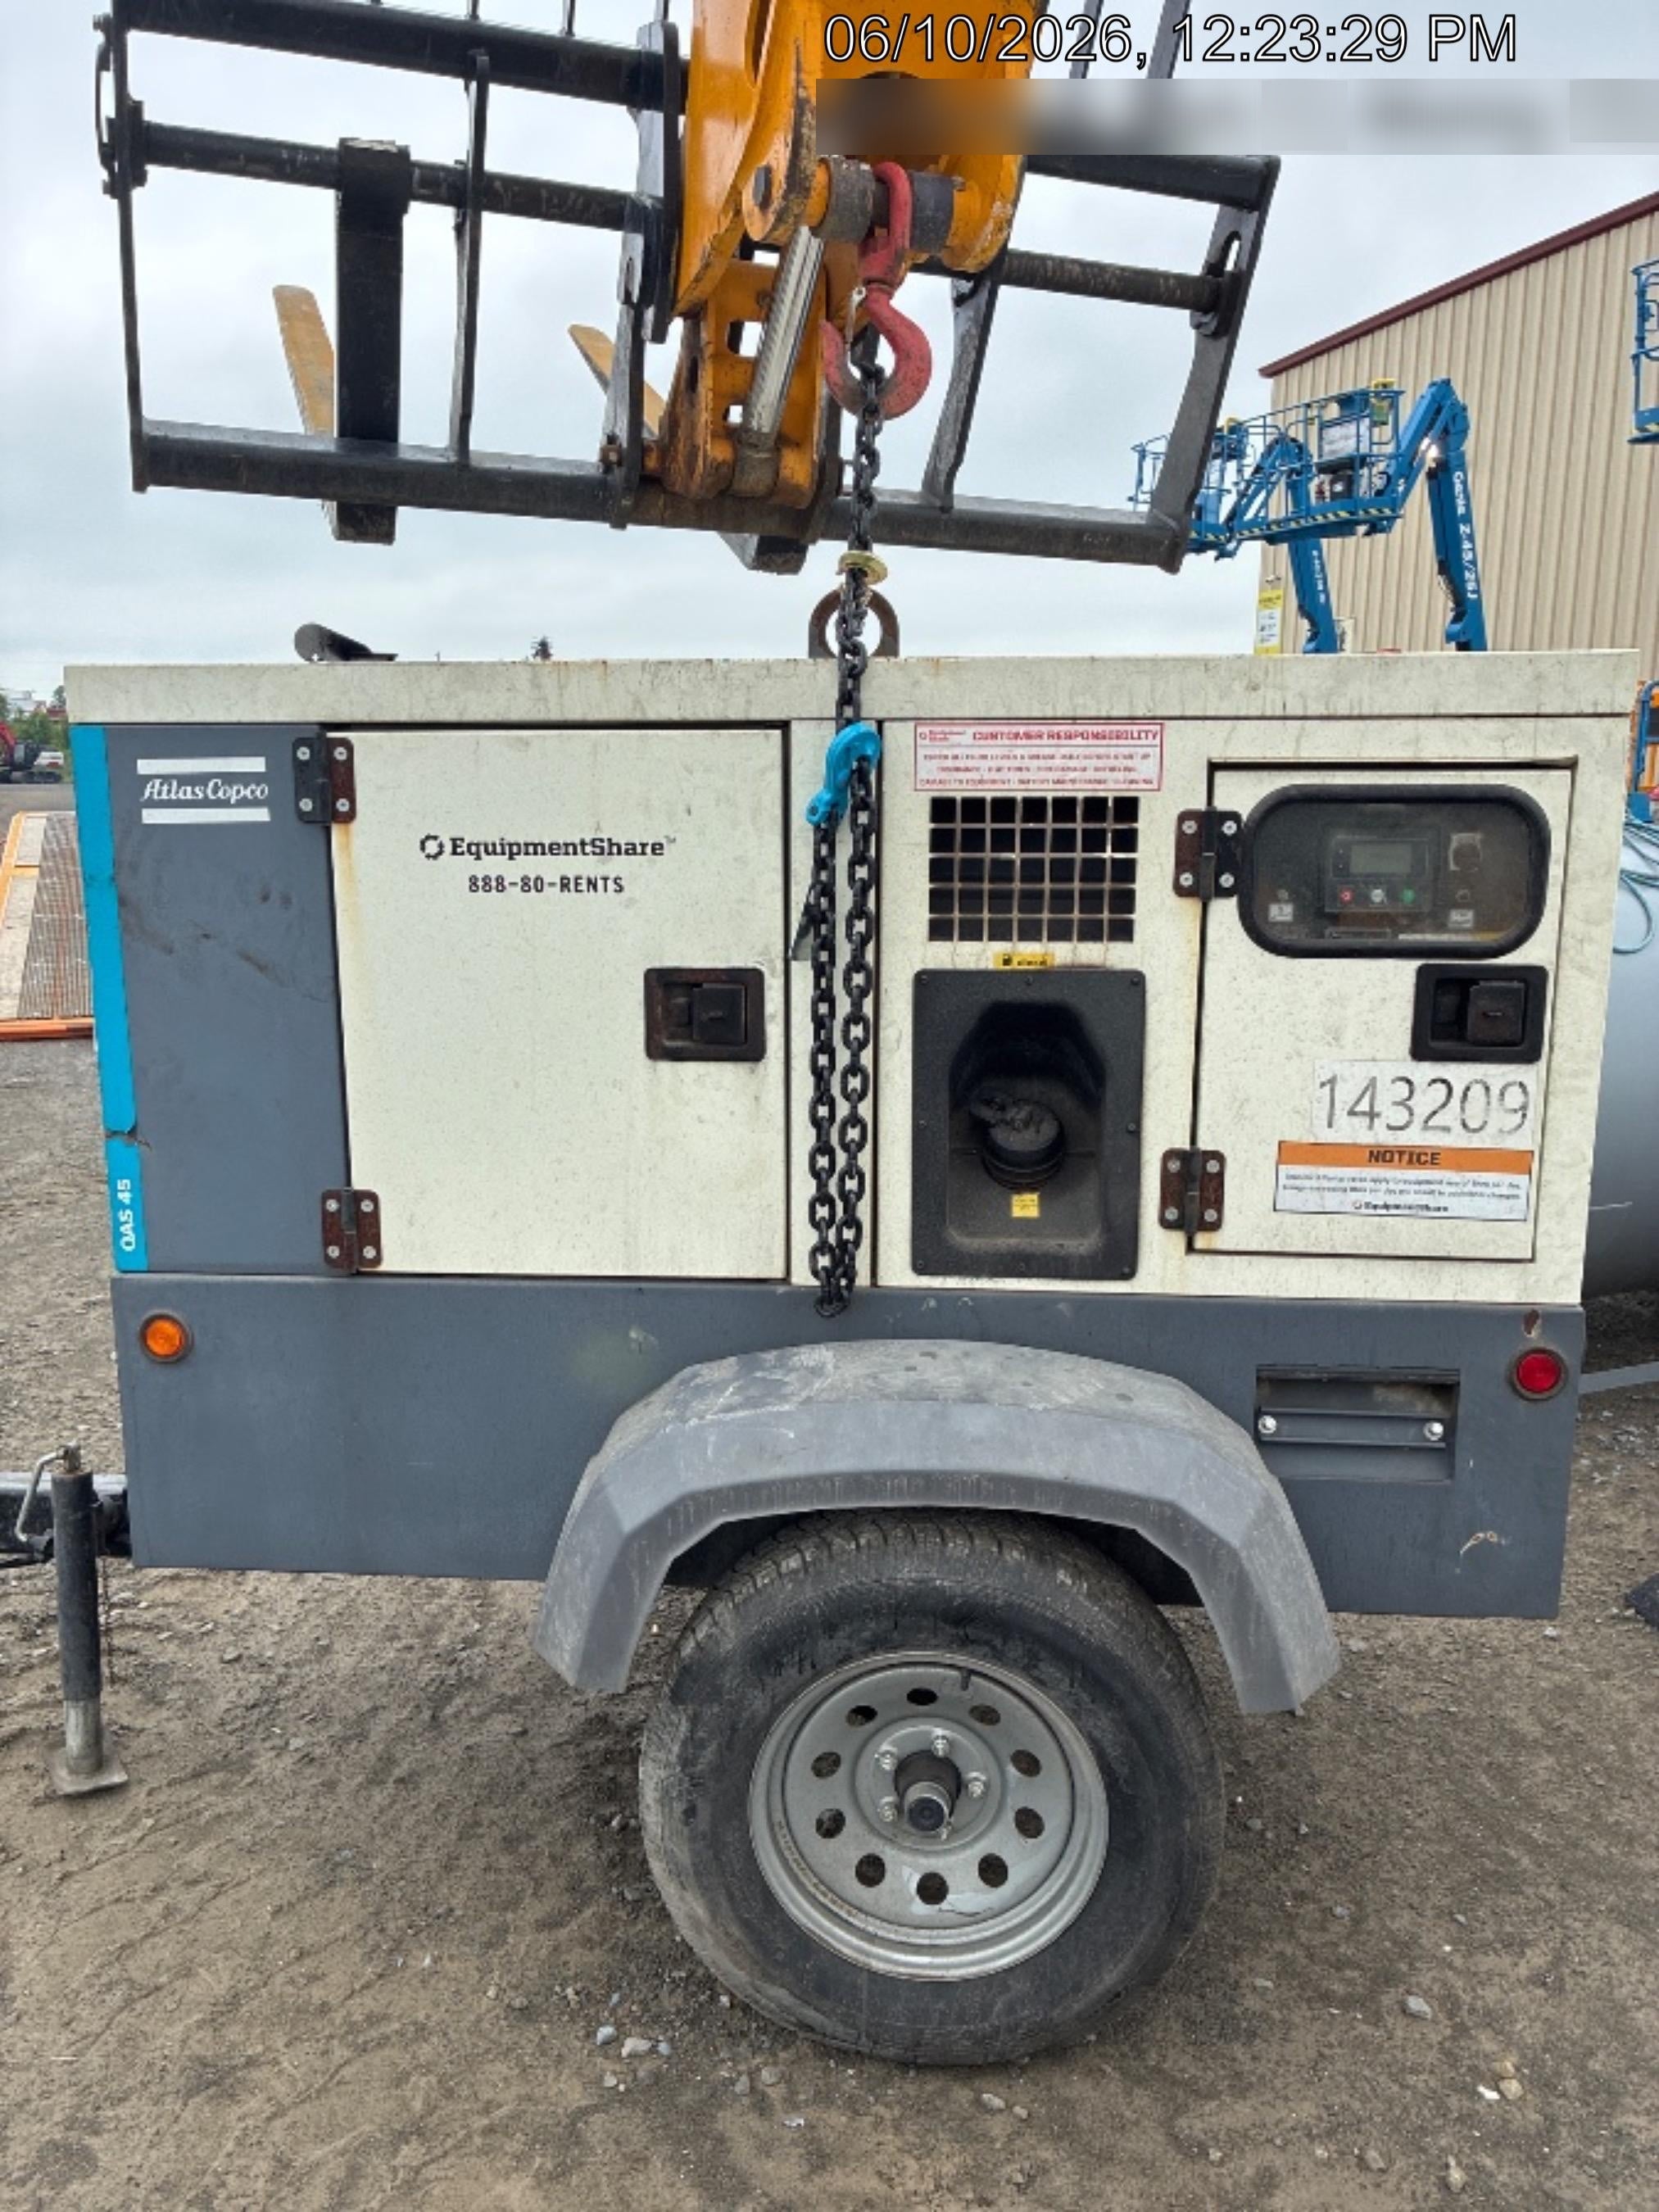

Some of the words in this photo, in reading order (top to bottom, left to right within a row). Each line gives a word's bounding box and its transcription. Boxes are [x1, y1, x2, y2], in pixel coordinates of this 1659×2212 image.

[139, 778, 204, 801] Atlas
[206, 778, 269, 805] Copco
[468, 874, 625, 894] 888-80-RENTS
[1319, 1072, 1530, 1135] 143209
[1367, 1149, 1442, 1166] NOTICE
[116, 1179, 131, 1204] 45
[118, 1208, 135, 1252] QAS
